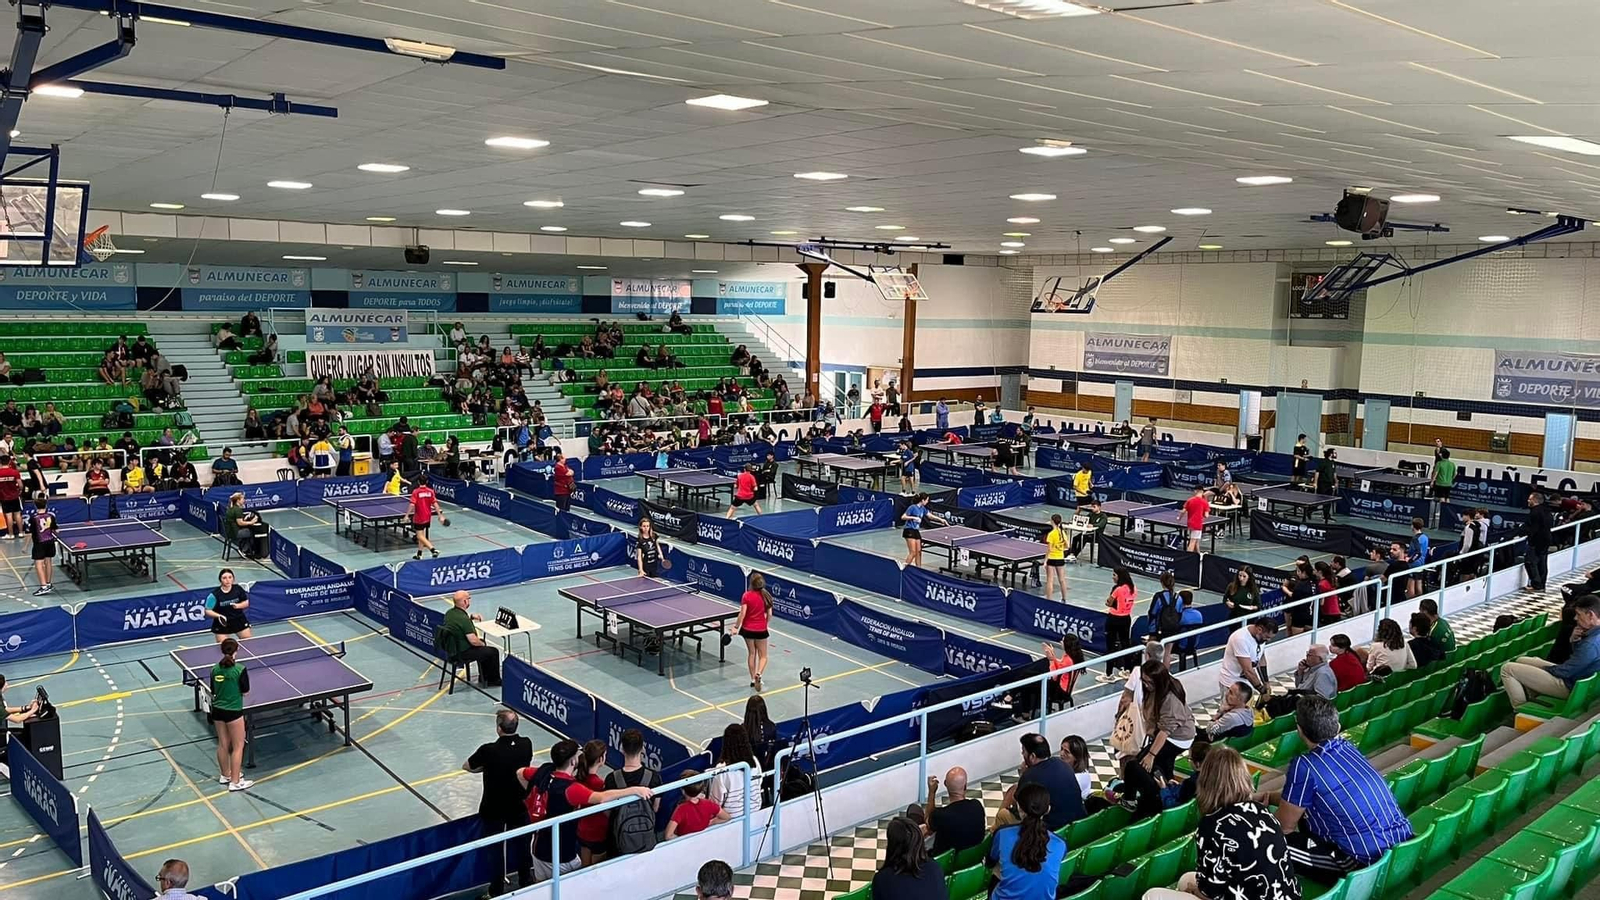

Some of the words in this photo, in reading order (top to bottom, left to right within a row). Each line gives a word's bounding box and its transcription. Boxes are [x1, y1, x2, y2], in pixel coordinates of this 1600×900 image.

[16, 291, 69, 301] DEPORTE
[70, 293, 78, 303] y
[81, 291, 107, 301] VIDA
[237, 293, 253, 301] del
[255, 293, 296, 303] DEPORTE
[363, 297, 397, 306] DEPORTE
[418, 297, 441, 306] TODOS
[310, 354, 343, 380] QUIERO
[346, 354, 374, 379] JUGAR
[376, 353, 391, 378] SIN
[392, 352, 432, 377] INSULTOS
[1518, 382, 1572, 397] DEPORTE
[323, 484, 370, 497] NARAQ
[1352, 497, 1415, 514] VSPORT
[836, 512, 874, 527] NARAQ
[1272, 521, 1327, 537] VSPORT
[757, 540, 794, 562] NARAQ
[430, 565, 491, 586] NARAQ
[300, 591, 319, 599] TENIS
[329, 588, 347, 596] MESA
[925, 585, 977, 612] NARAQ
[125, 605, 160, 615] TABLE
[166, 599, 206, 610] TENNIS
[123, 605, 205, 631] NARAQ
[1064, 615, 1095, 628] TENNIS
[1033, 612, 1094, 644] NARAQ
[523, 684, 568, 726] NARAQ
